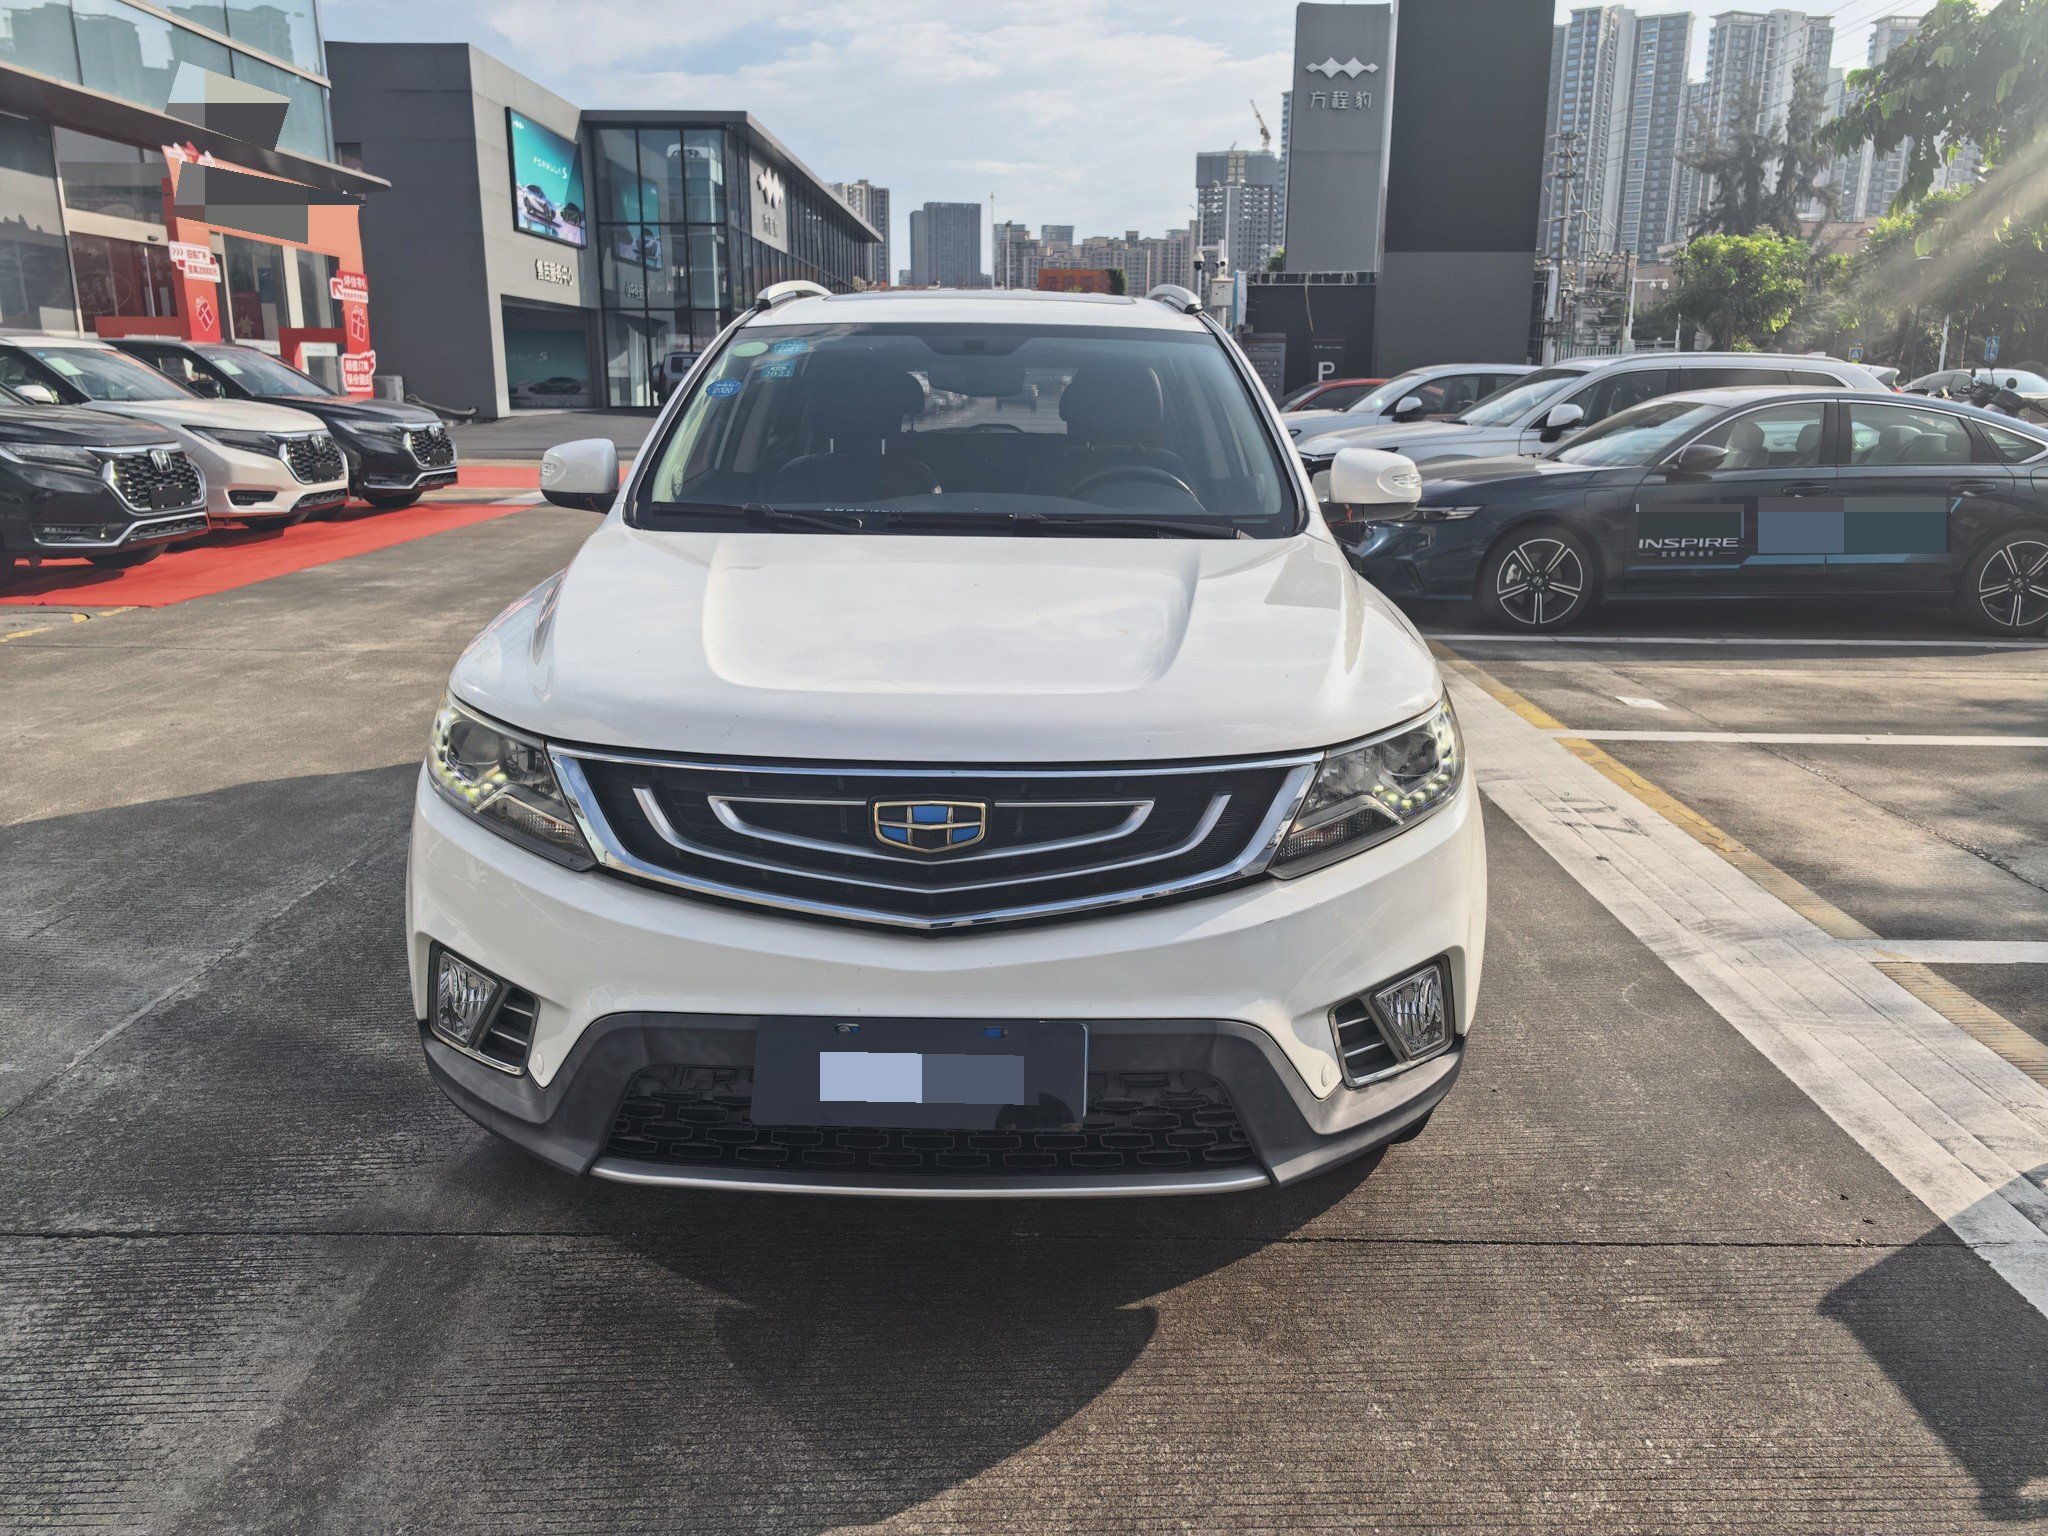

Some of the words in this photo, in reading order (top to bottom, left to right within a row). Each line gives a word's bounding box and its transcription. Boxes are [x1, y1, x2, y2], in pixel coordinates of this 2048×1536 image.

[1309, 90, 1372, 110] 方程豹
[535, 258, 574, 287] 售后服务中心
[1318, 361, 1335, 382] P
[1638, 537, 1739, 549] INSPIRE
